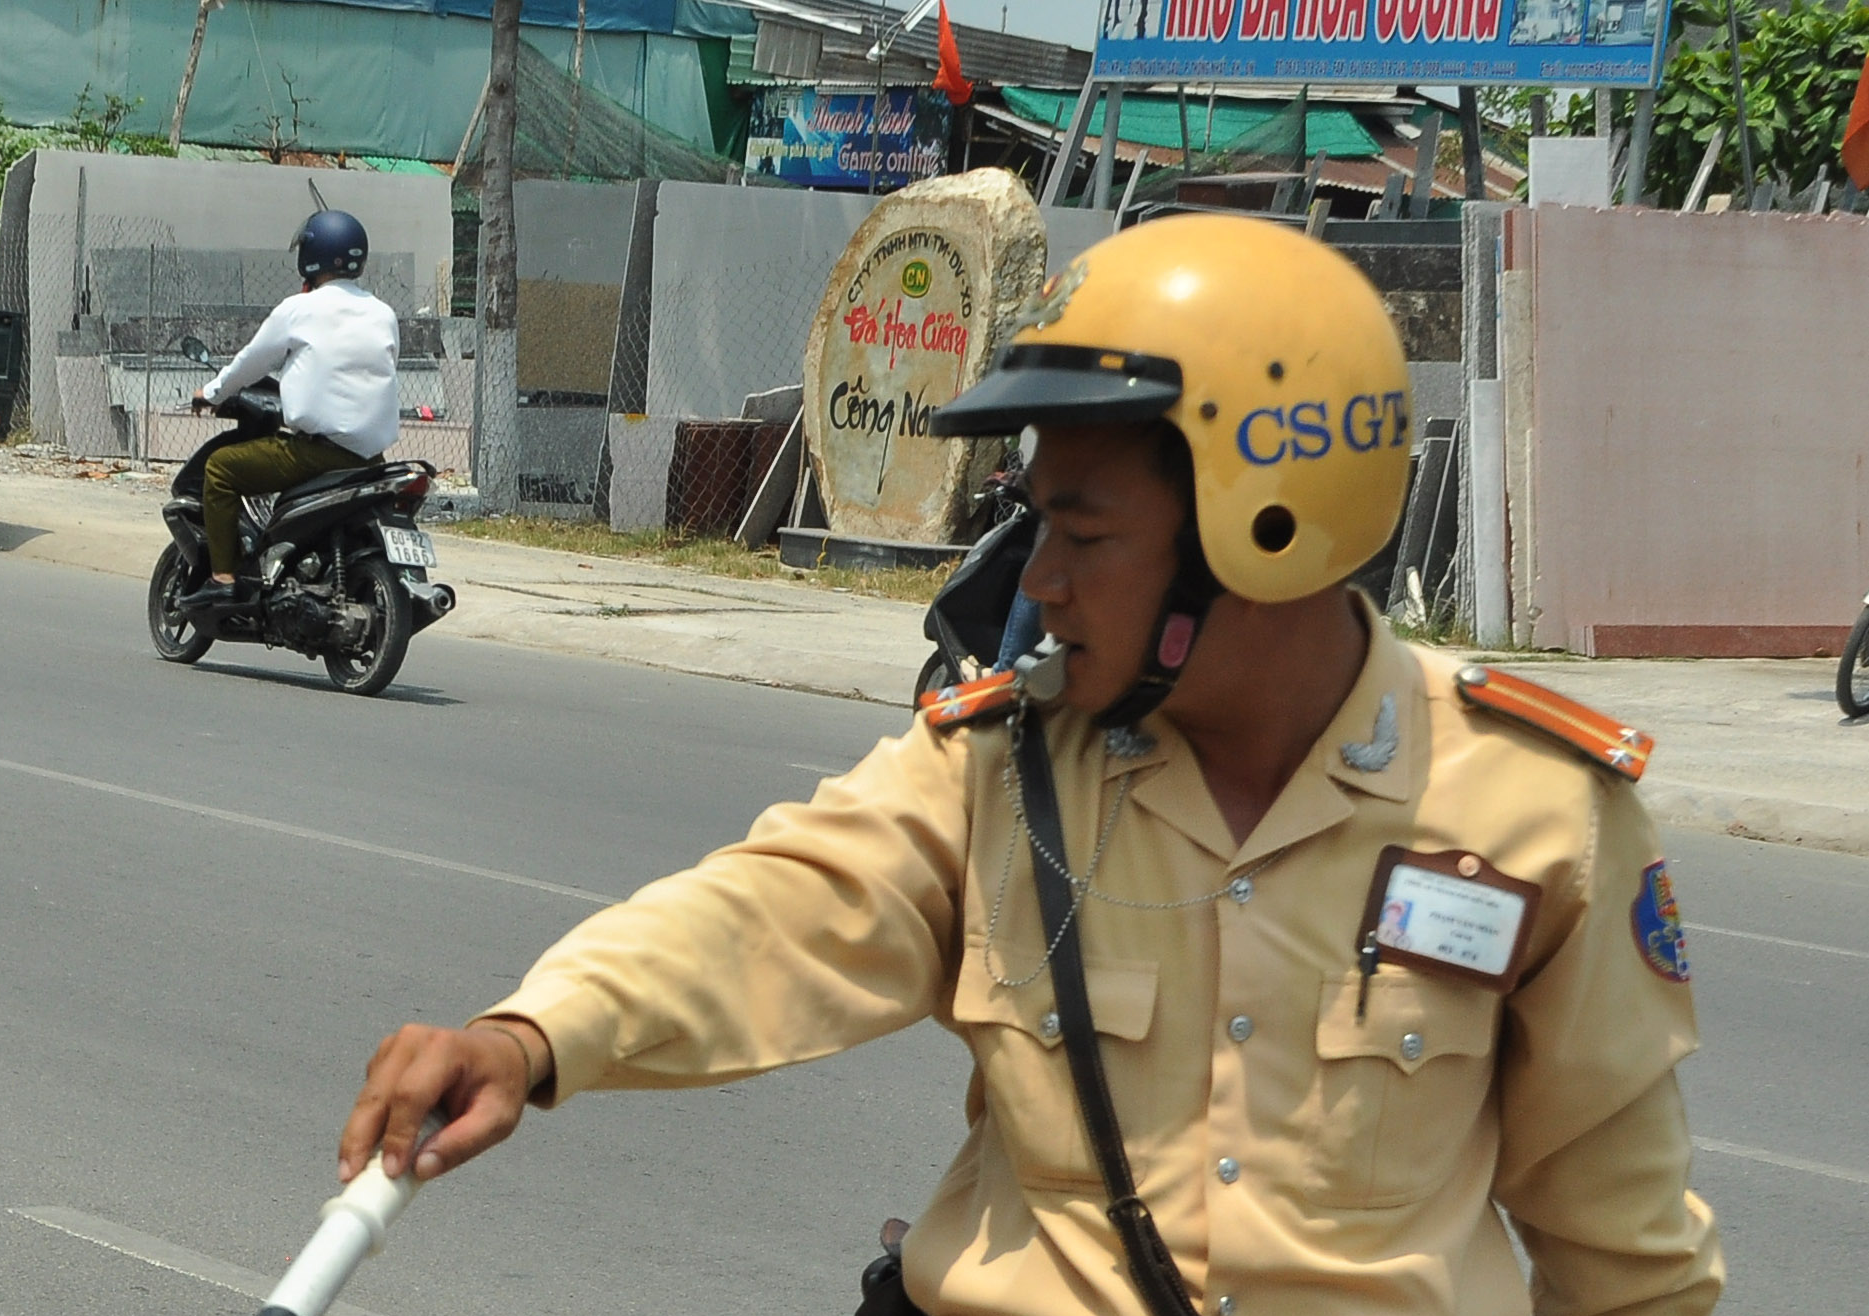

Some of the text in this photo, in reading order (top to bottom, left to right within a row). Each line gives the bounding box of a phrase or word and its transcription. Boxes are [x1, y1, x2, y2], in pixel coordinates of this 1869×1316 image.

[838, 142, 940, 175] Game online
[848, 261, 871, 303] CTY
[874, 234, 906, 266] TNHH
[908, 232, 931, 249] MTV
[907, 268, 925, 287] CN
[844, 298, 885, 345] Đá
[884, 299, 917, 370] Hoa
[899, 383, 940, 437] Na
[395, 547, 429, 566] 1666
